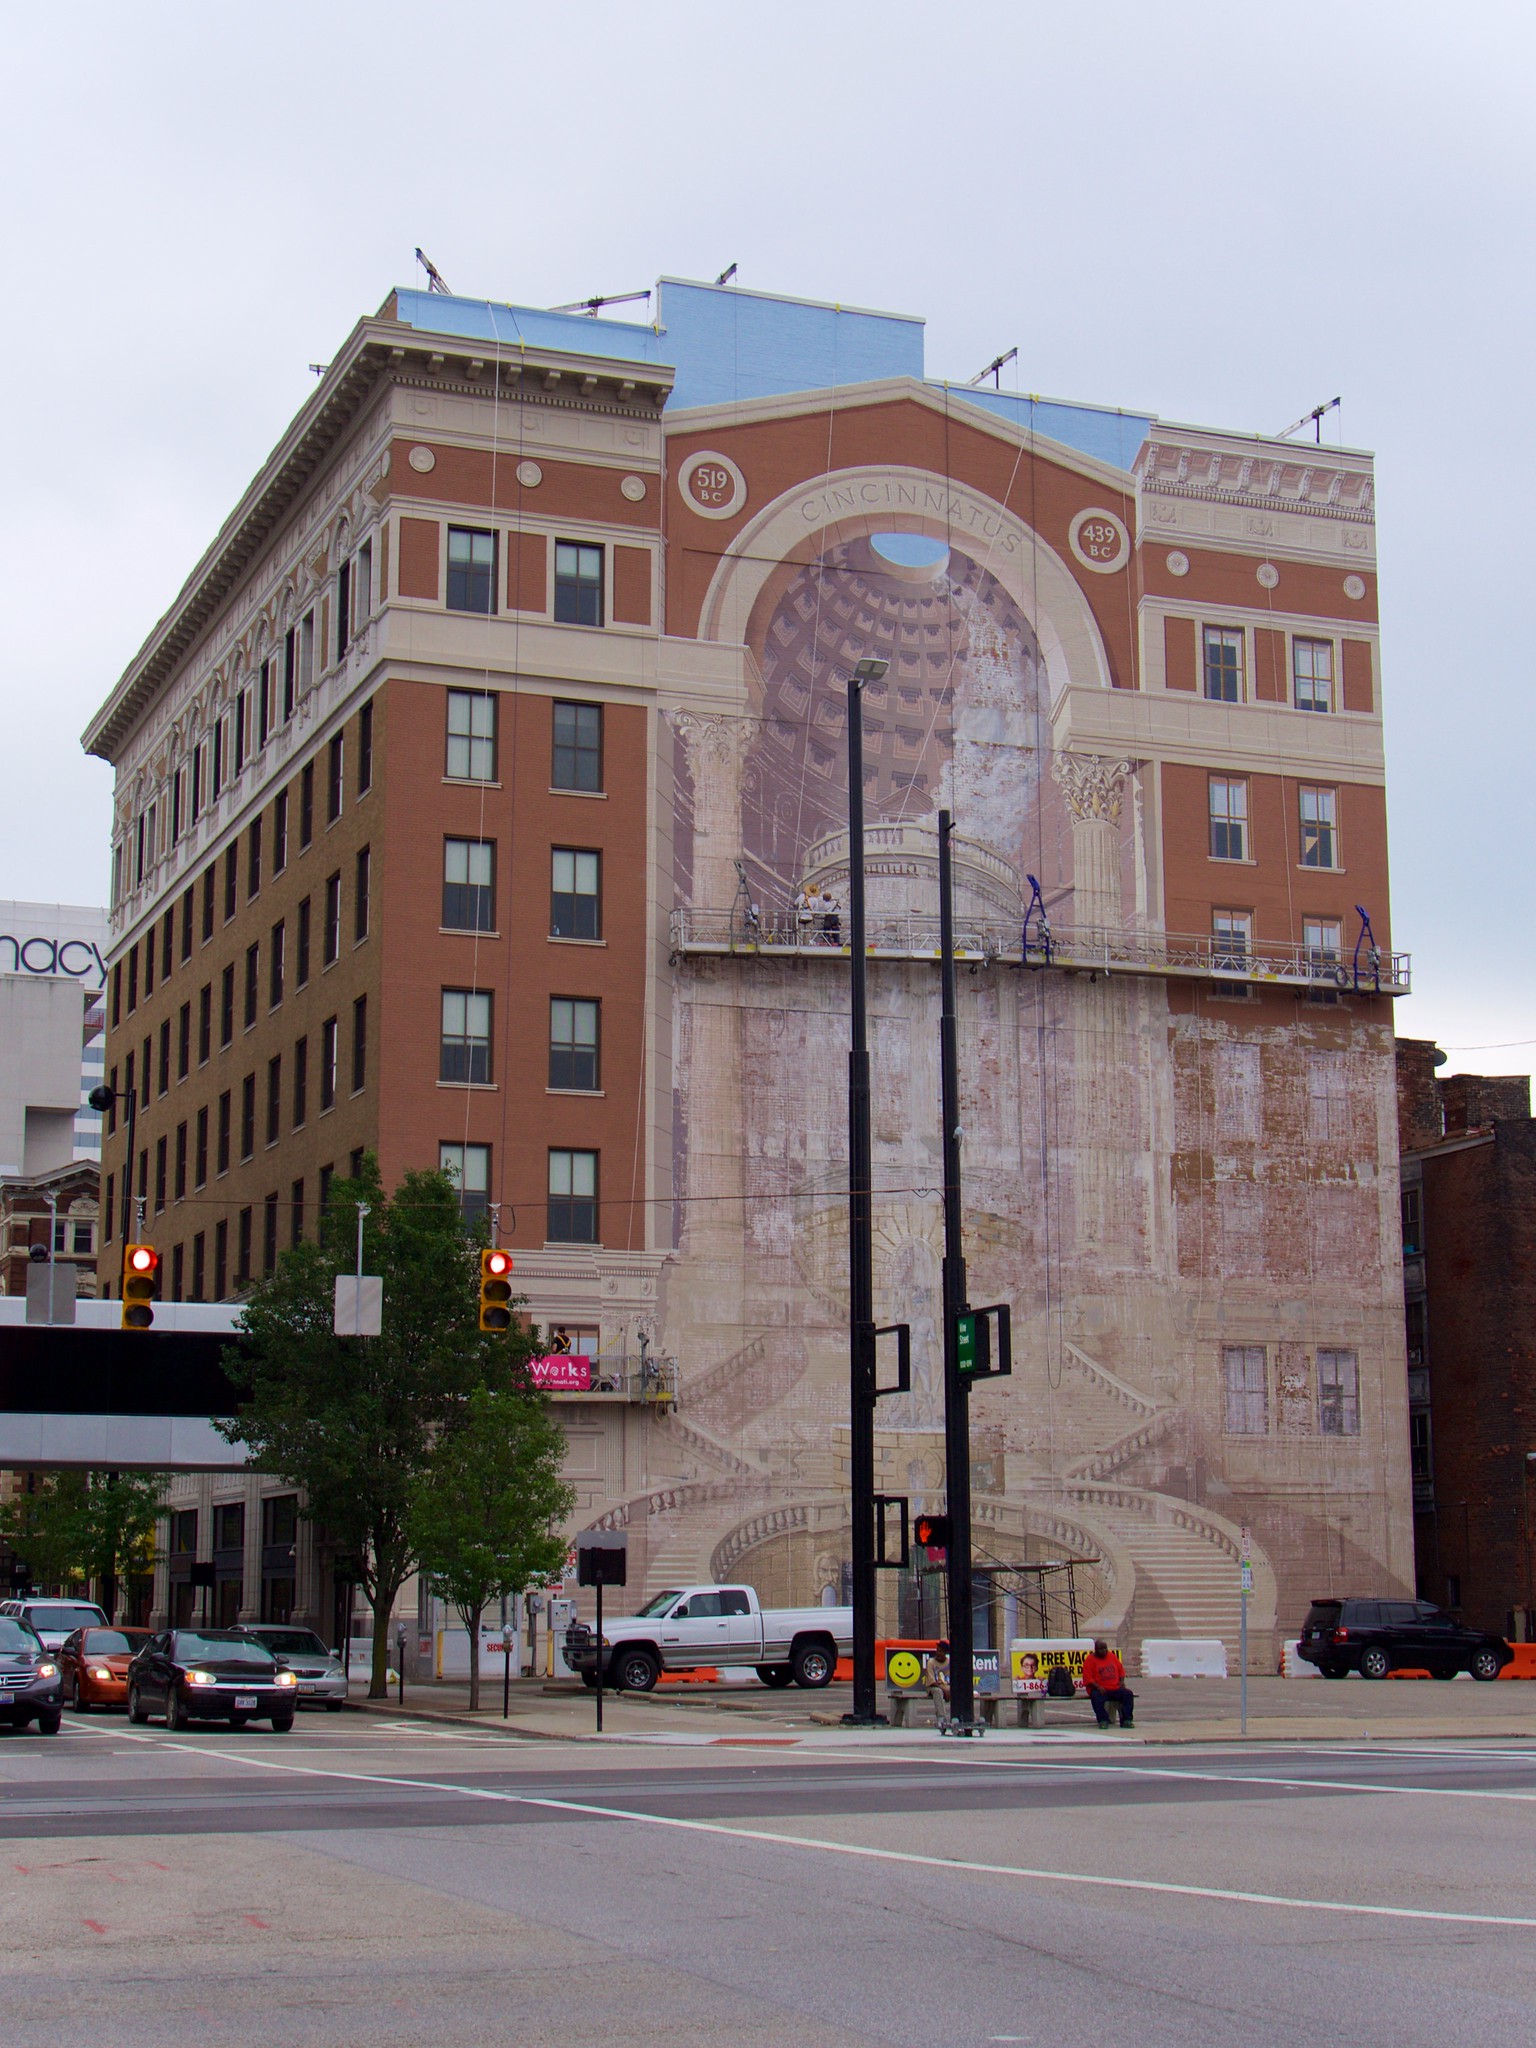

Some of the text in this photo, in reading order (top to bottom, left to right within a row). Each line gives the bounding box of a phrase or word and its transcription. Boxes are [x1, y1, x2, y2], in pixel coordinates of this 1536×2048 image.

[697, 468, 728, 489] 519
[801, 483, 1021, 553] CINCINNATUS
[1082, 525, 1115, 543] 439
[1041, 1651, 1065, 1666] FREE
